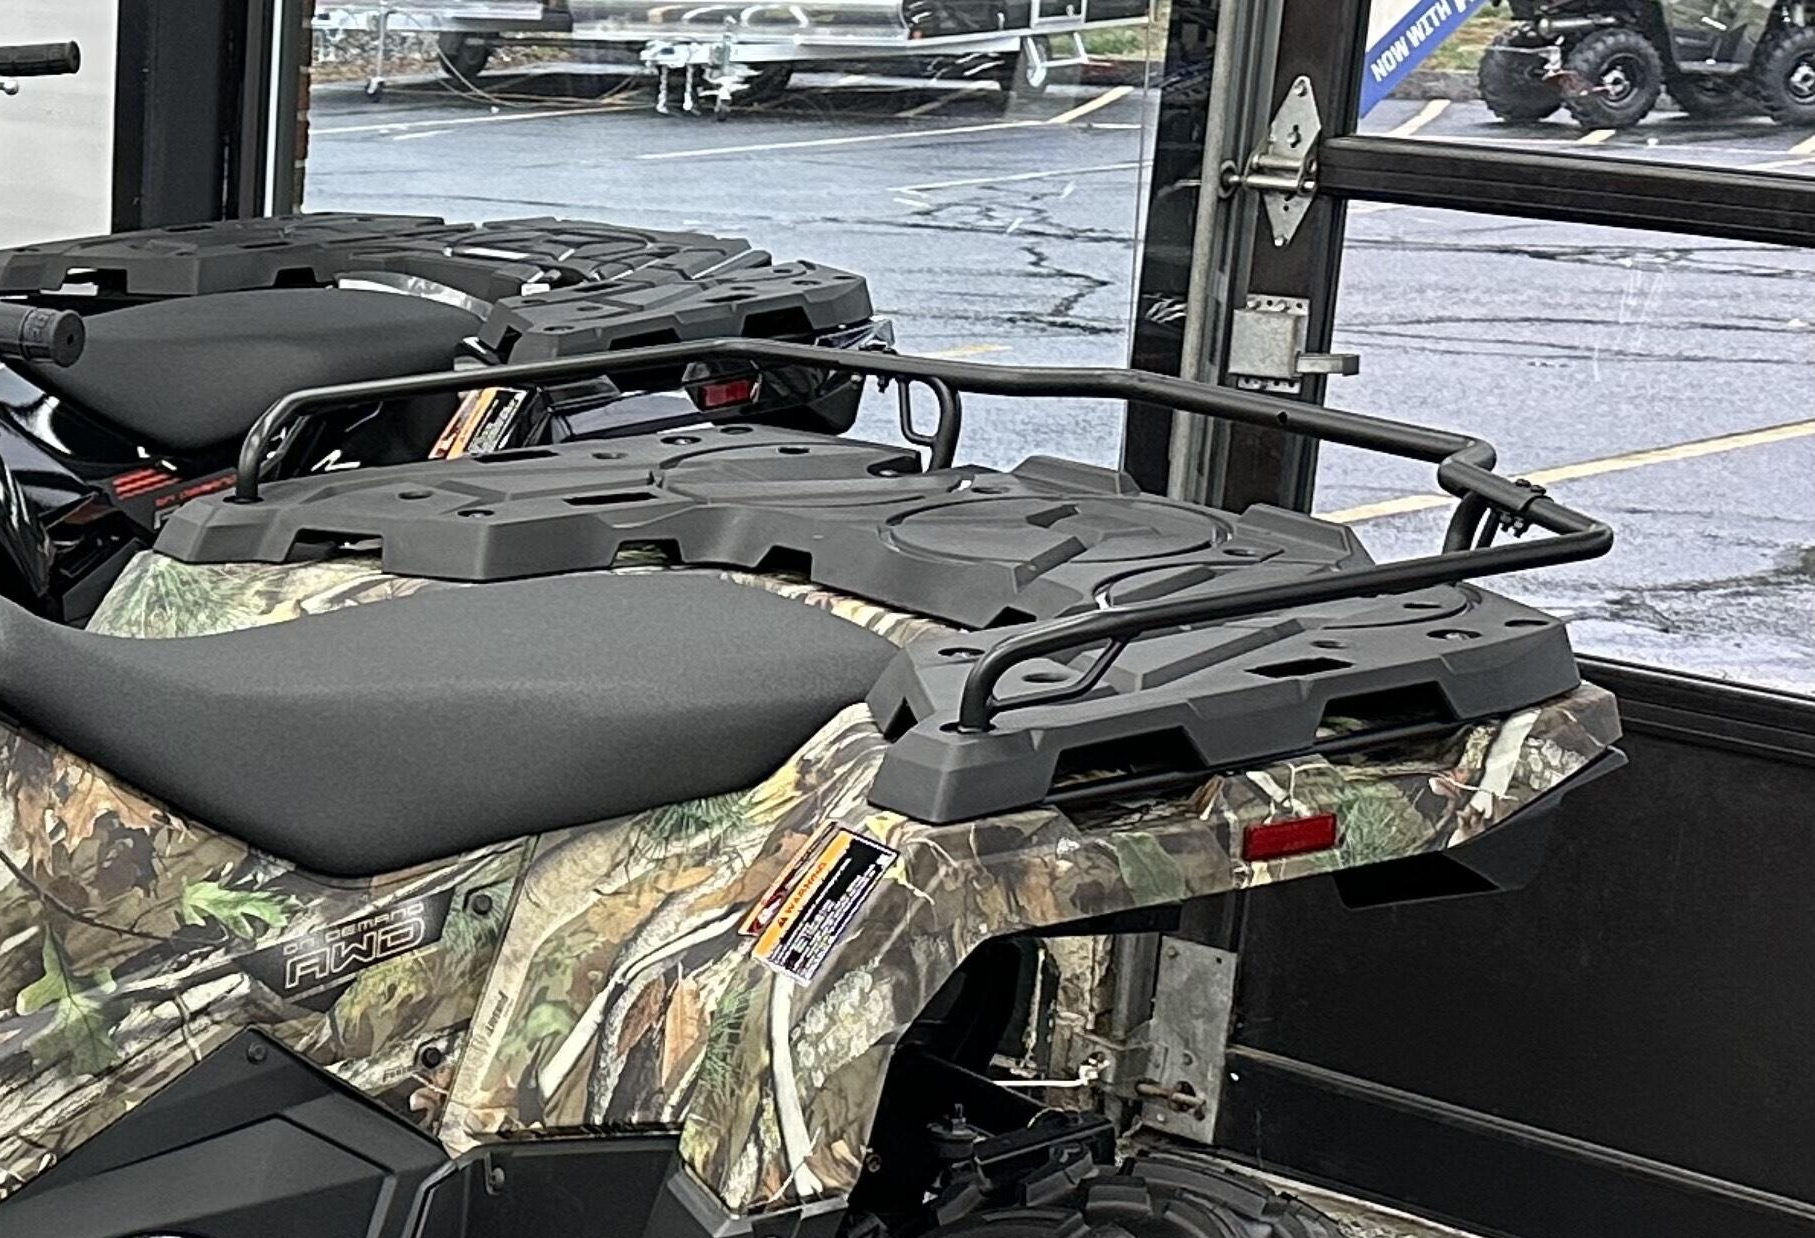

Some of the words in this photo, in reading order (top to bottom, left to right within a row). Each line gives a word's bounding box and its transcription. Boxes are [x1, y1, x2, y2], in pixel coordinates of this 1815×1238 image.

[1370, 36, 1410, 83] NOW
[1405, 0, 1454, 49] WITH
[284, 917, 427, 990] AWD
